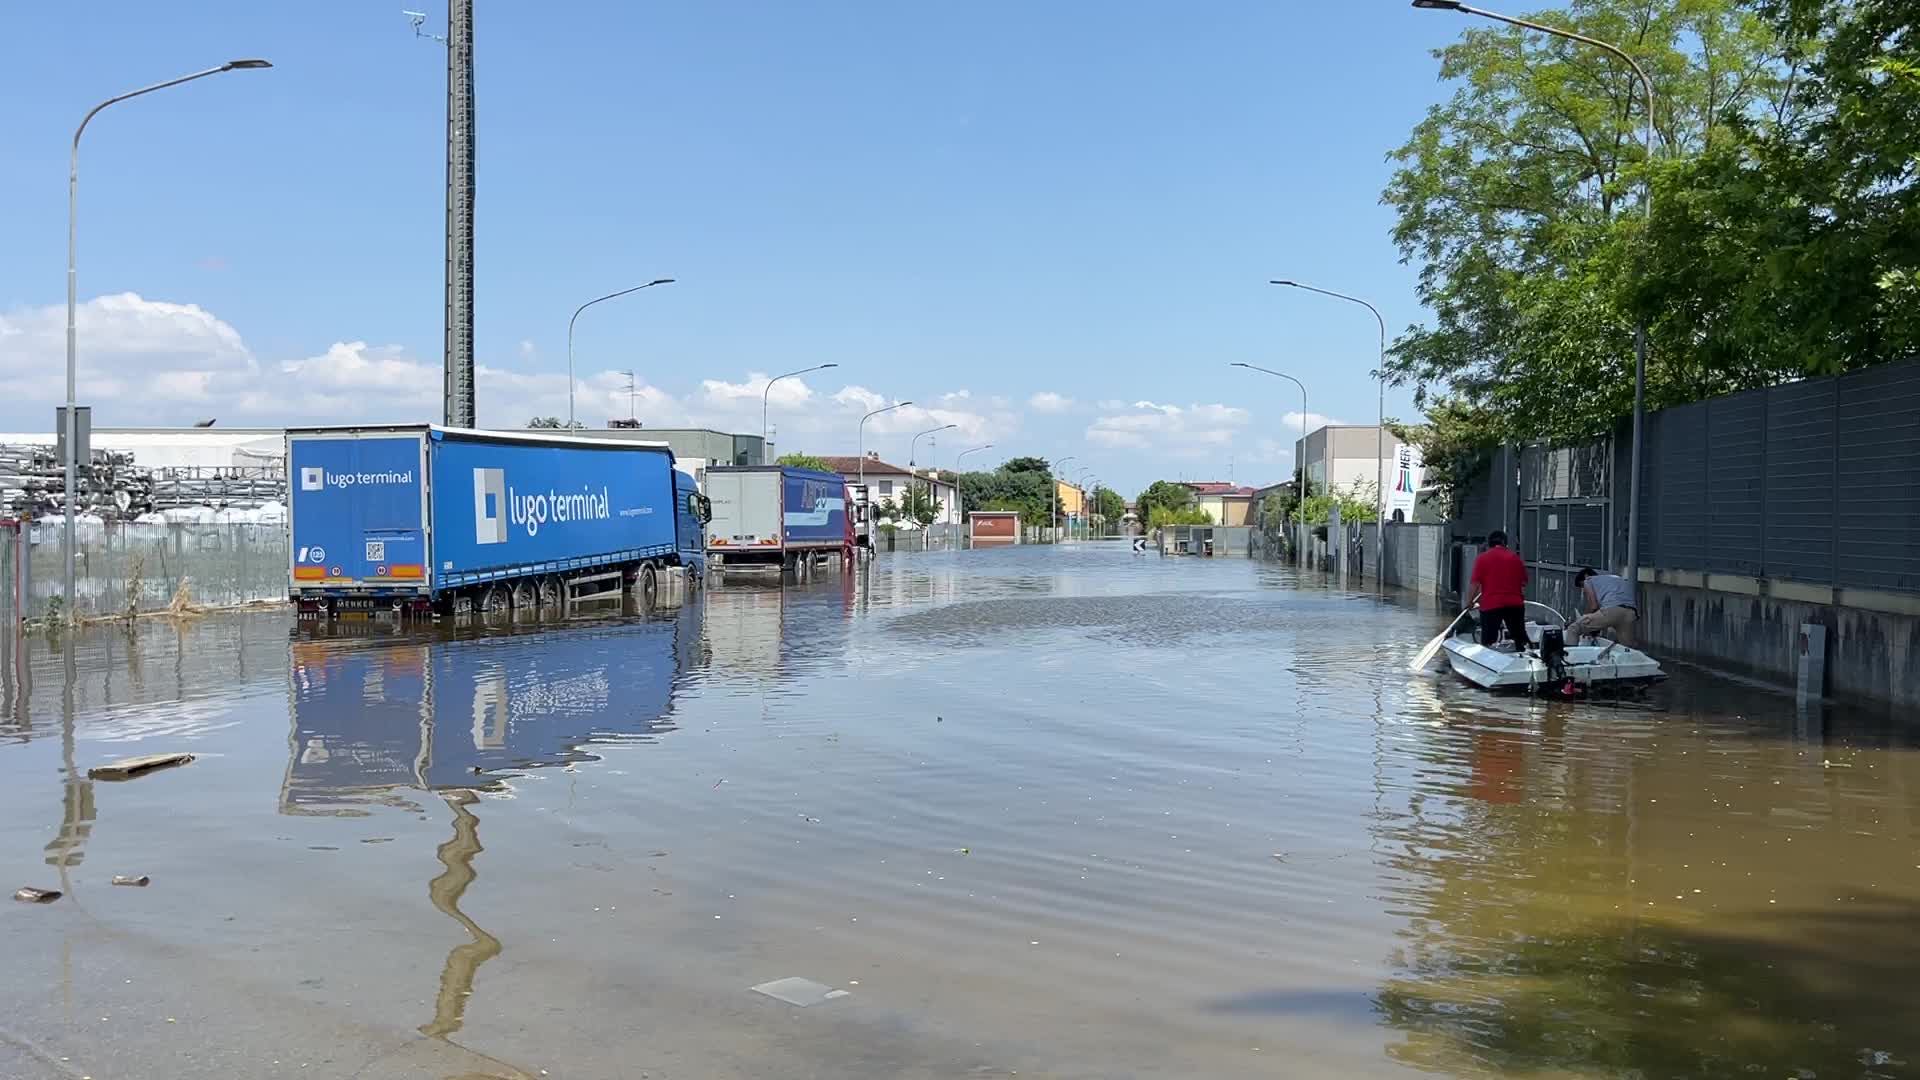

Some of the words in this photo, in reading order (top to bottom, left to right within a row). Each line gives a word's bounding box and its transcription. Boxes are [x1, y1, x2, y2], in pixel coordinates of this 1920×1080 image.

[326, 471, 355, 488] lugo
[357, 470, 412, 484] terminal
[509, 486, 547, 536] lugo
[550, 484, 610, 522] terminal
